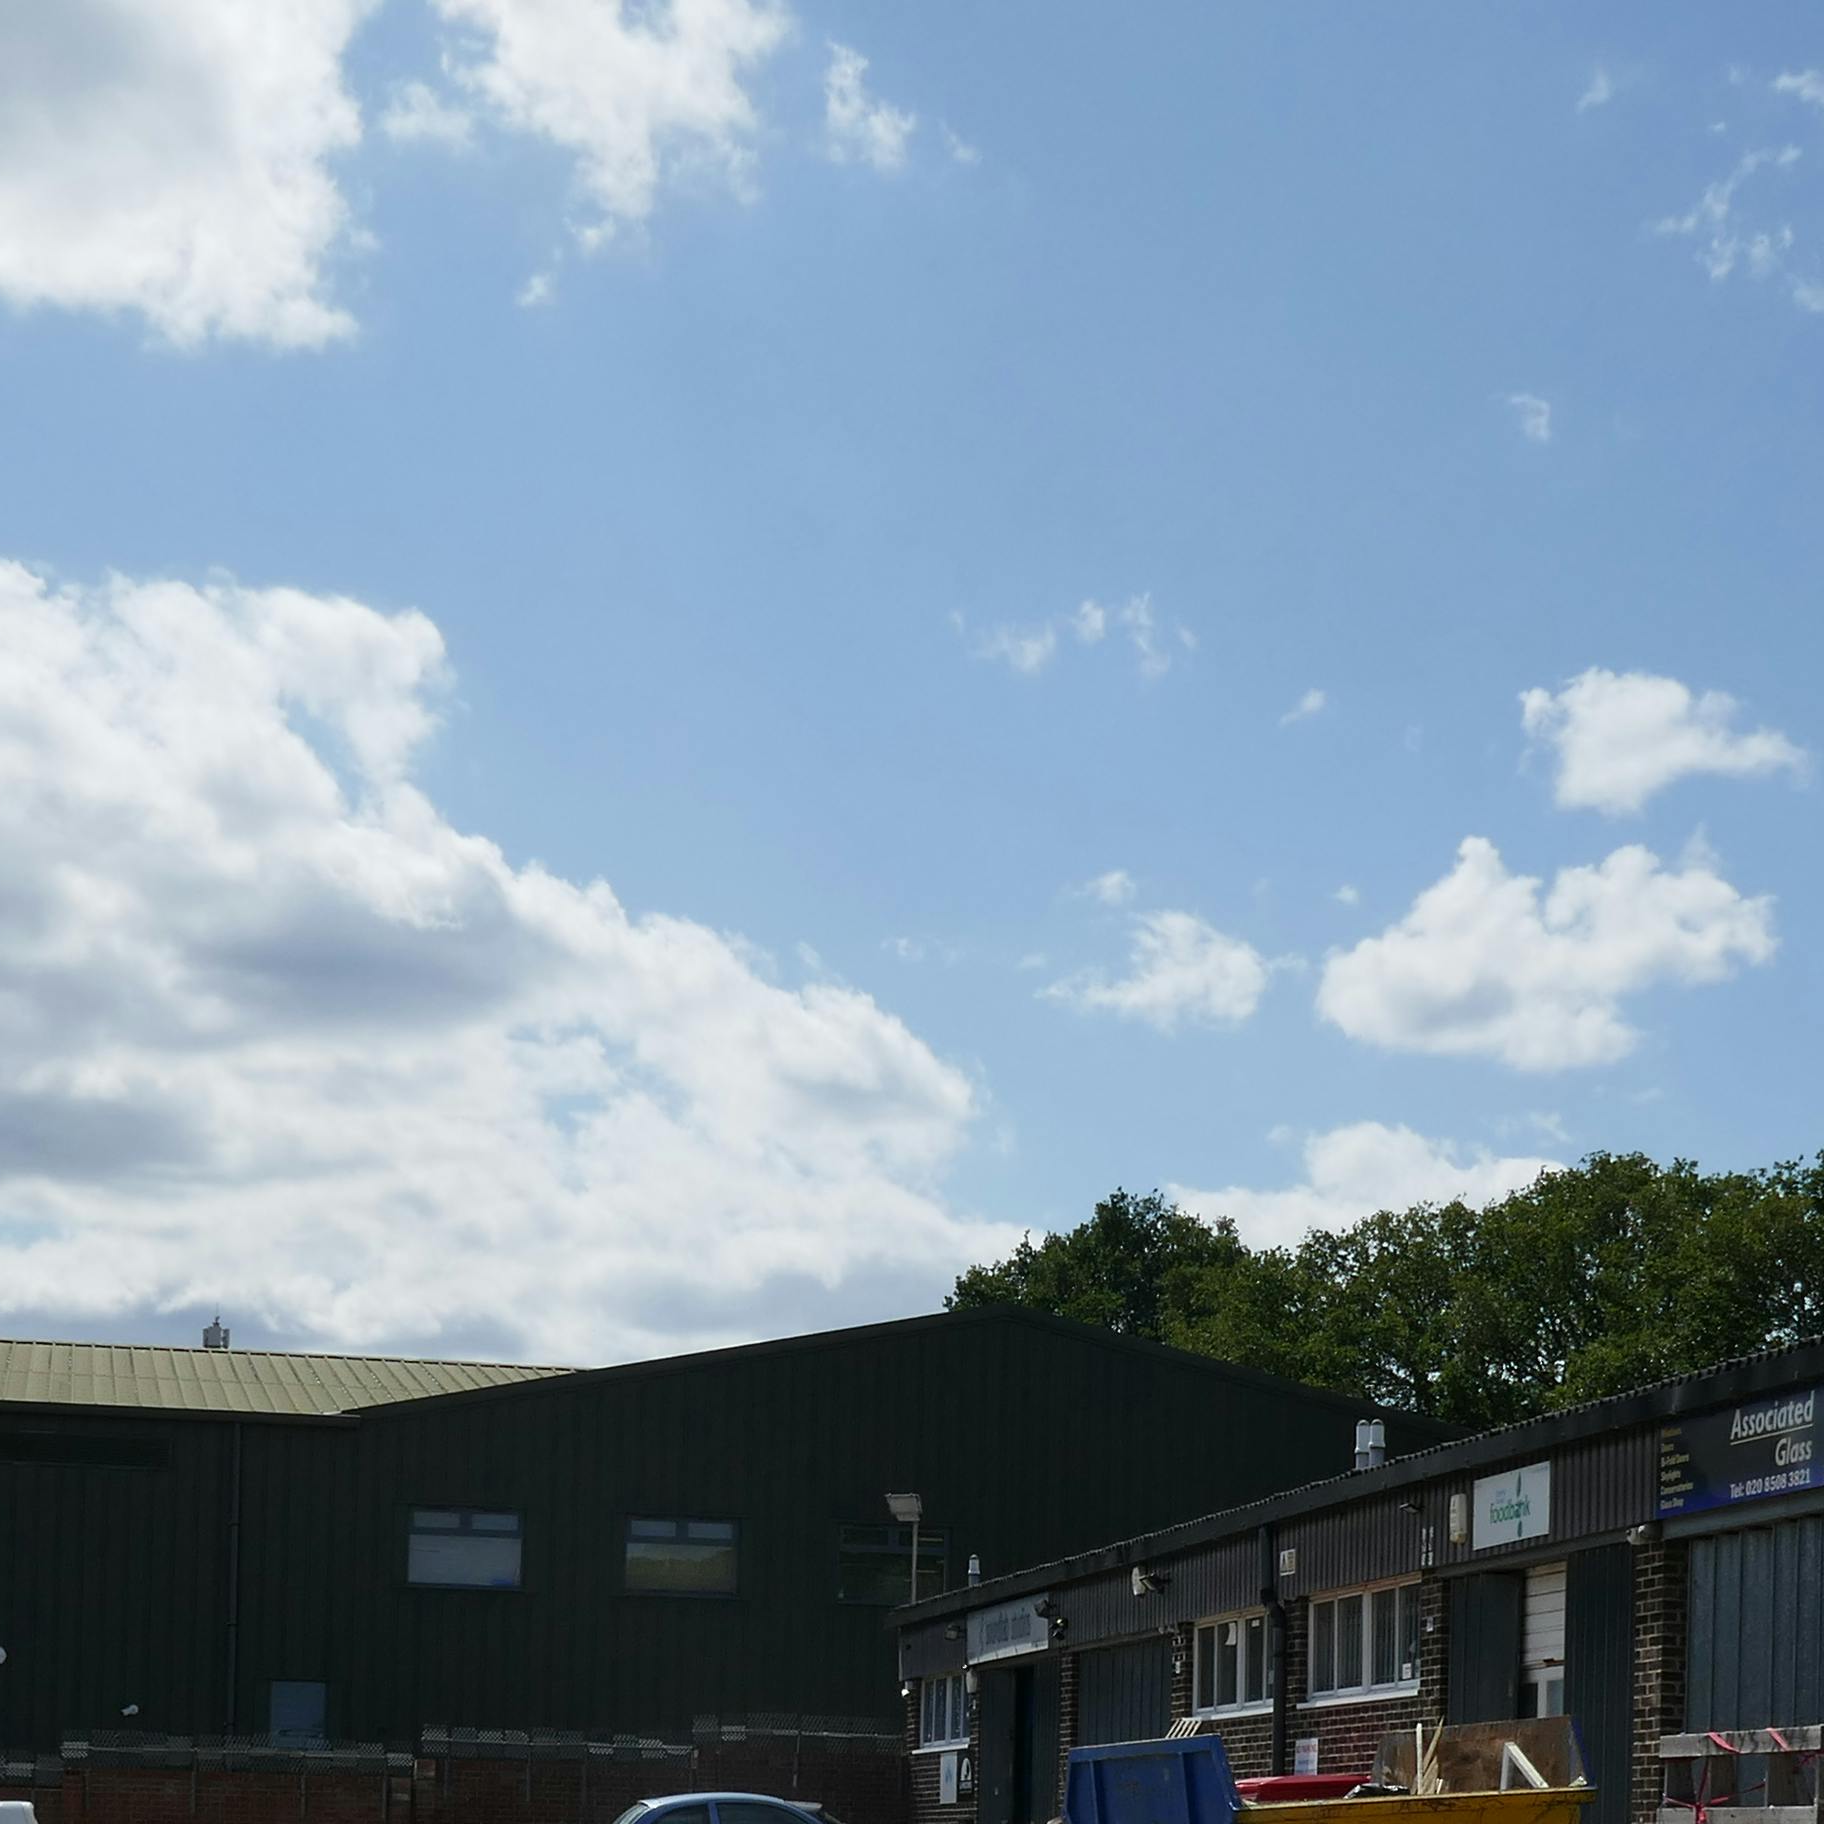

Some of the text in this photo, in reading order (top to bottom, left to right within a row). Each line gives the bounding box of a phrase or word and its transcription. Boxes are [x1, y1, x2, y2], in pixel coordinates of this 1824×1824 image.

[1730, 1389, 1816, 1441] Associated
[1775, 1437, 1813, 1466] Glass
[1746, 1478, 1763, 1496] 020
